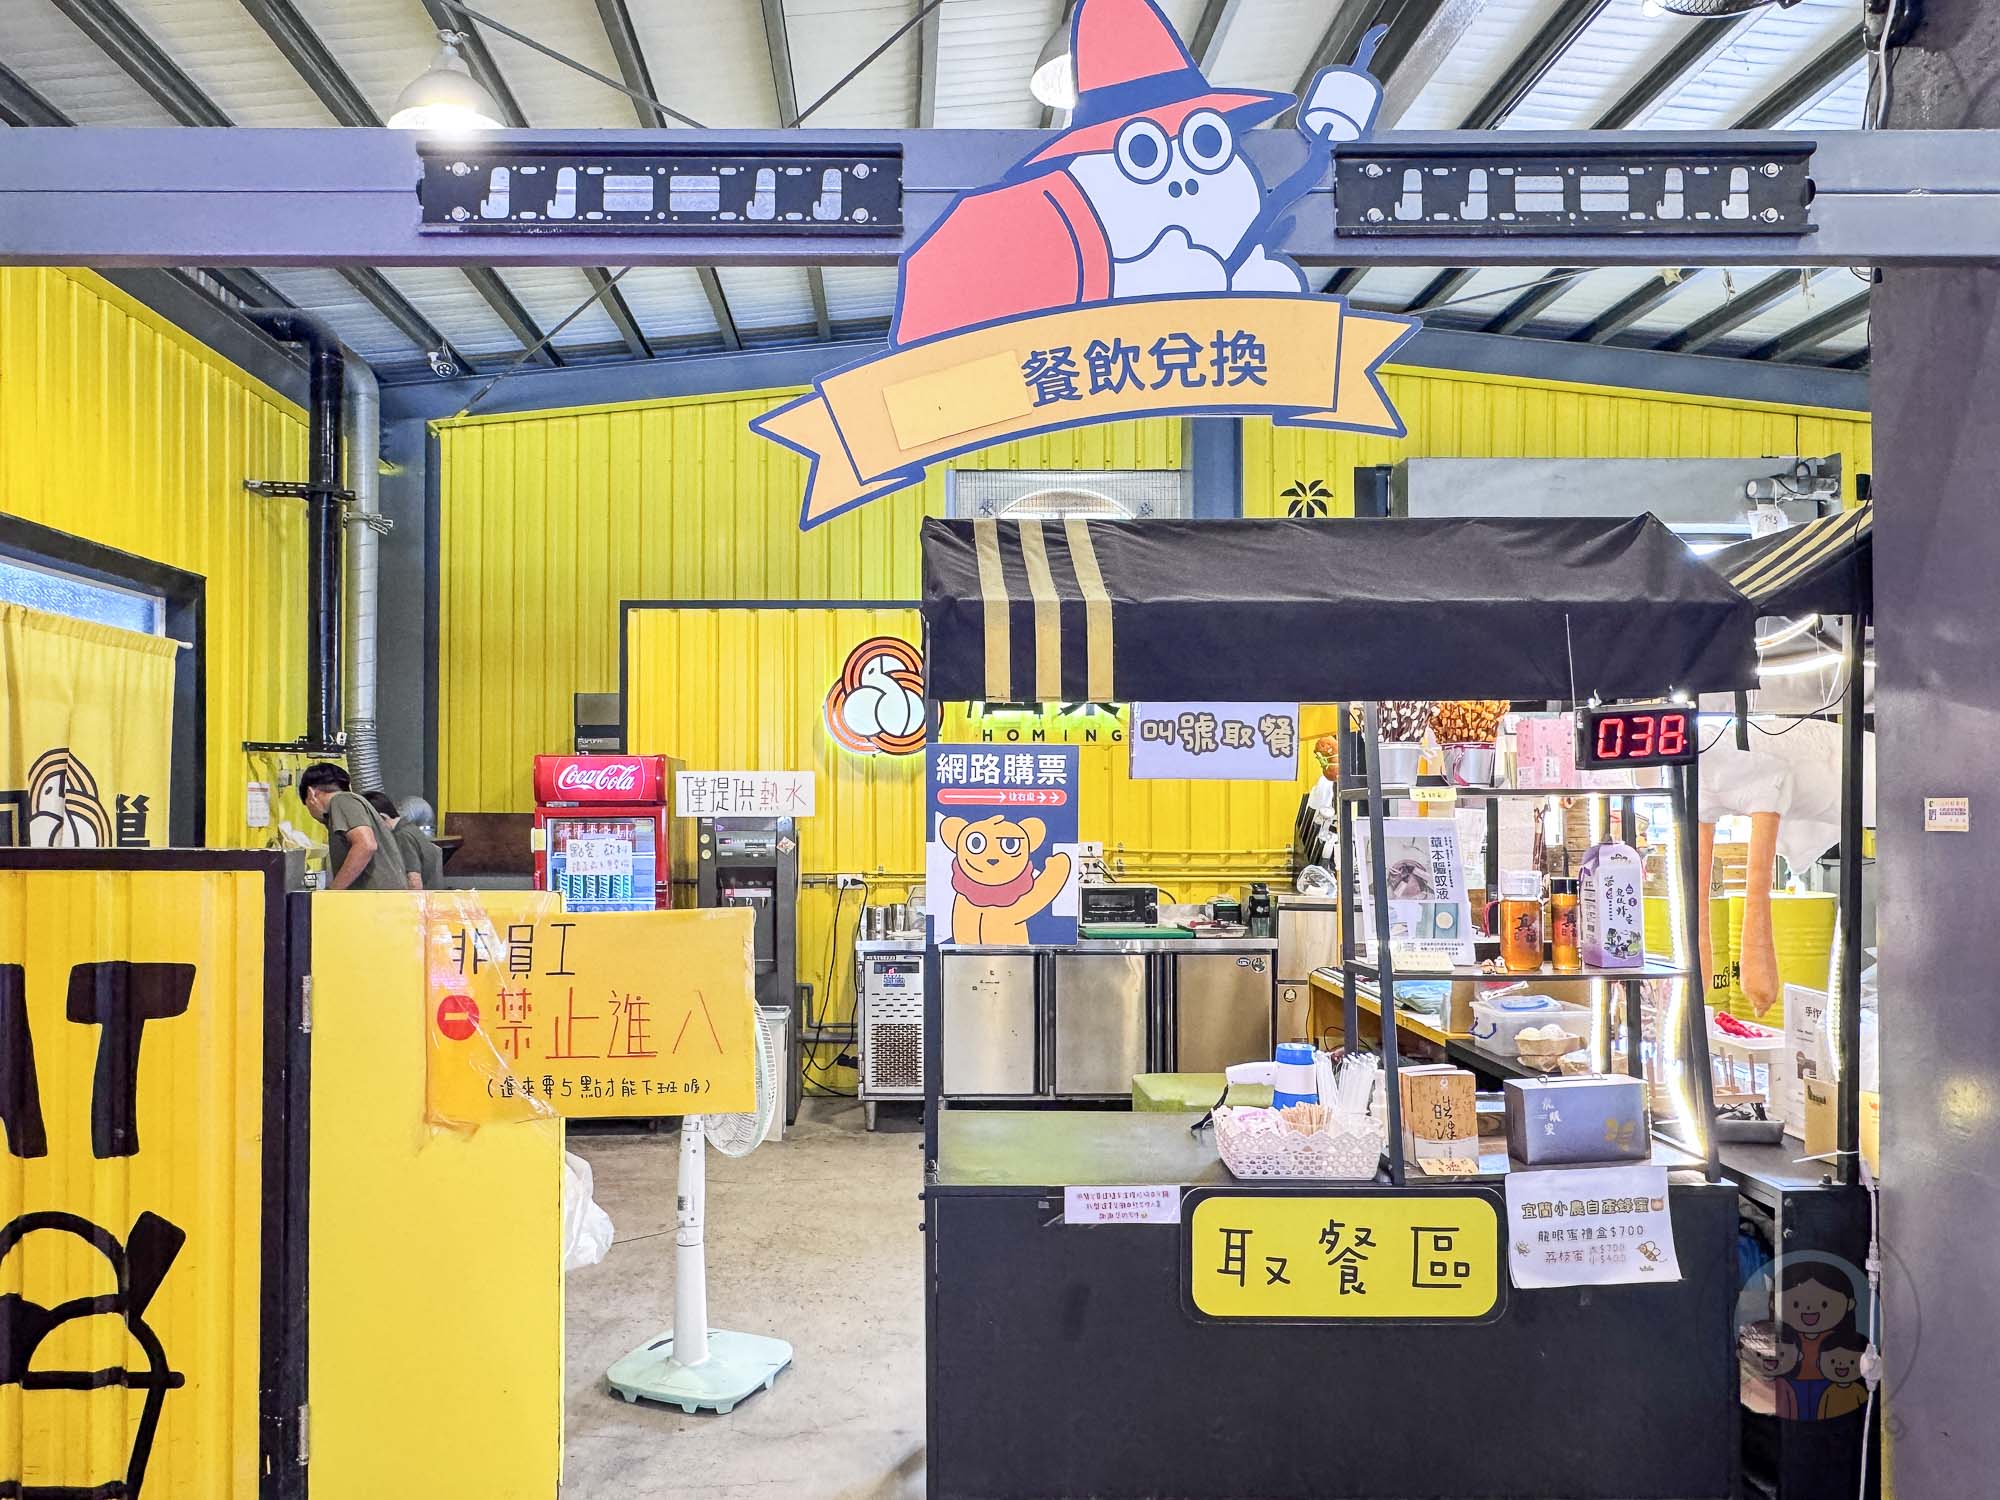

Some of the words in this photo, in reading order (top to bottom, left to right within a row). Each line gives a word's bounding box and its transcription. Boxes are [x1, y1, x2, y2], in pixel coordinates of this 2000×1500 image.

[1022, 329, 1268, 408] 餐飲兌換
[982, 729, 1122, 742] HOMING
[1138, 712, 1295, 758] 叫號取餐
[1597, 714, 1686, 758] 038
[936, 752, 1068, 785] 網路購票
[682, 776, 807, 814] 僅提供熱水
[451, 922, 577, 980] 非員工
[495, 986, 723, 1060] 禁止進入
[1521, 1197, 1649, 1219] 宜蘭小農自產蜂蜜
[1217, 1219, 1470, 1295] 取餐區
